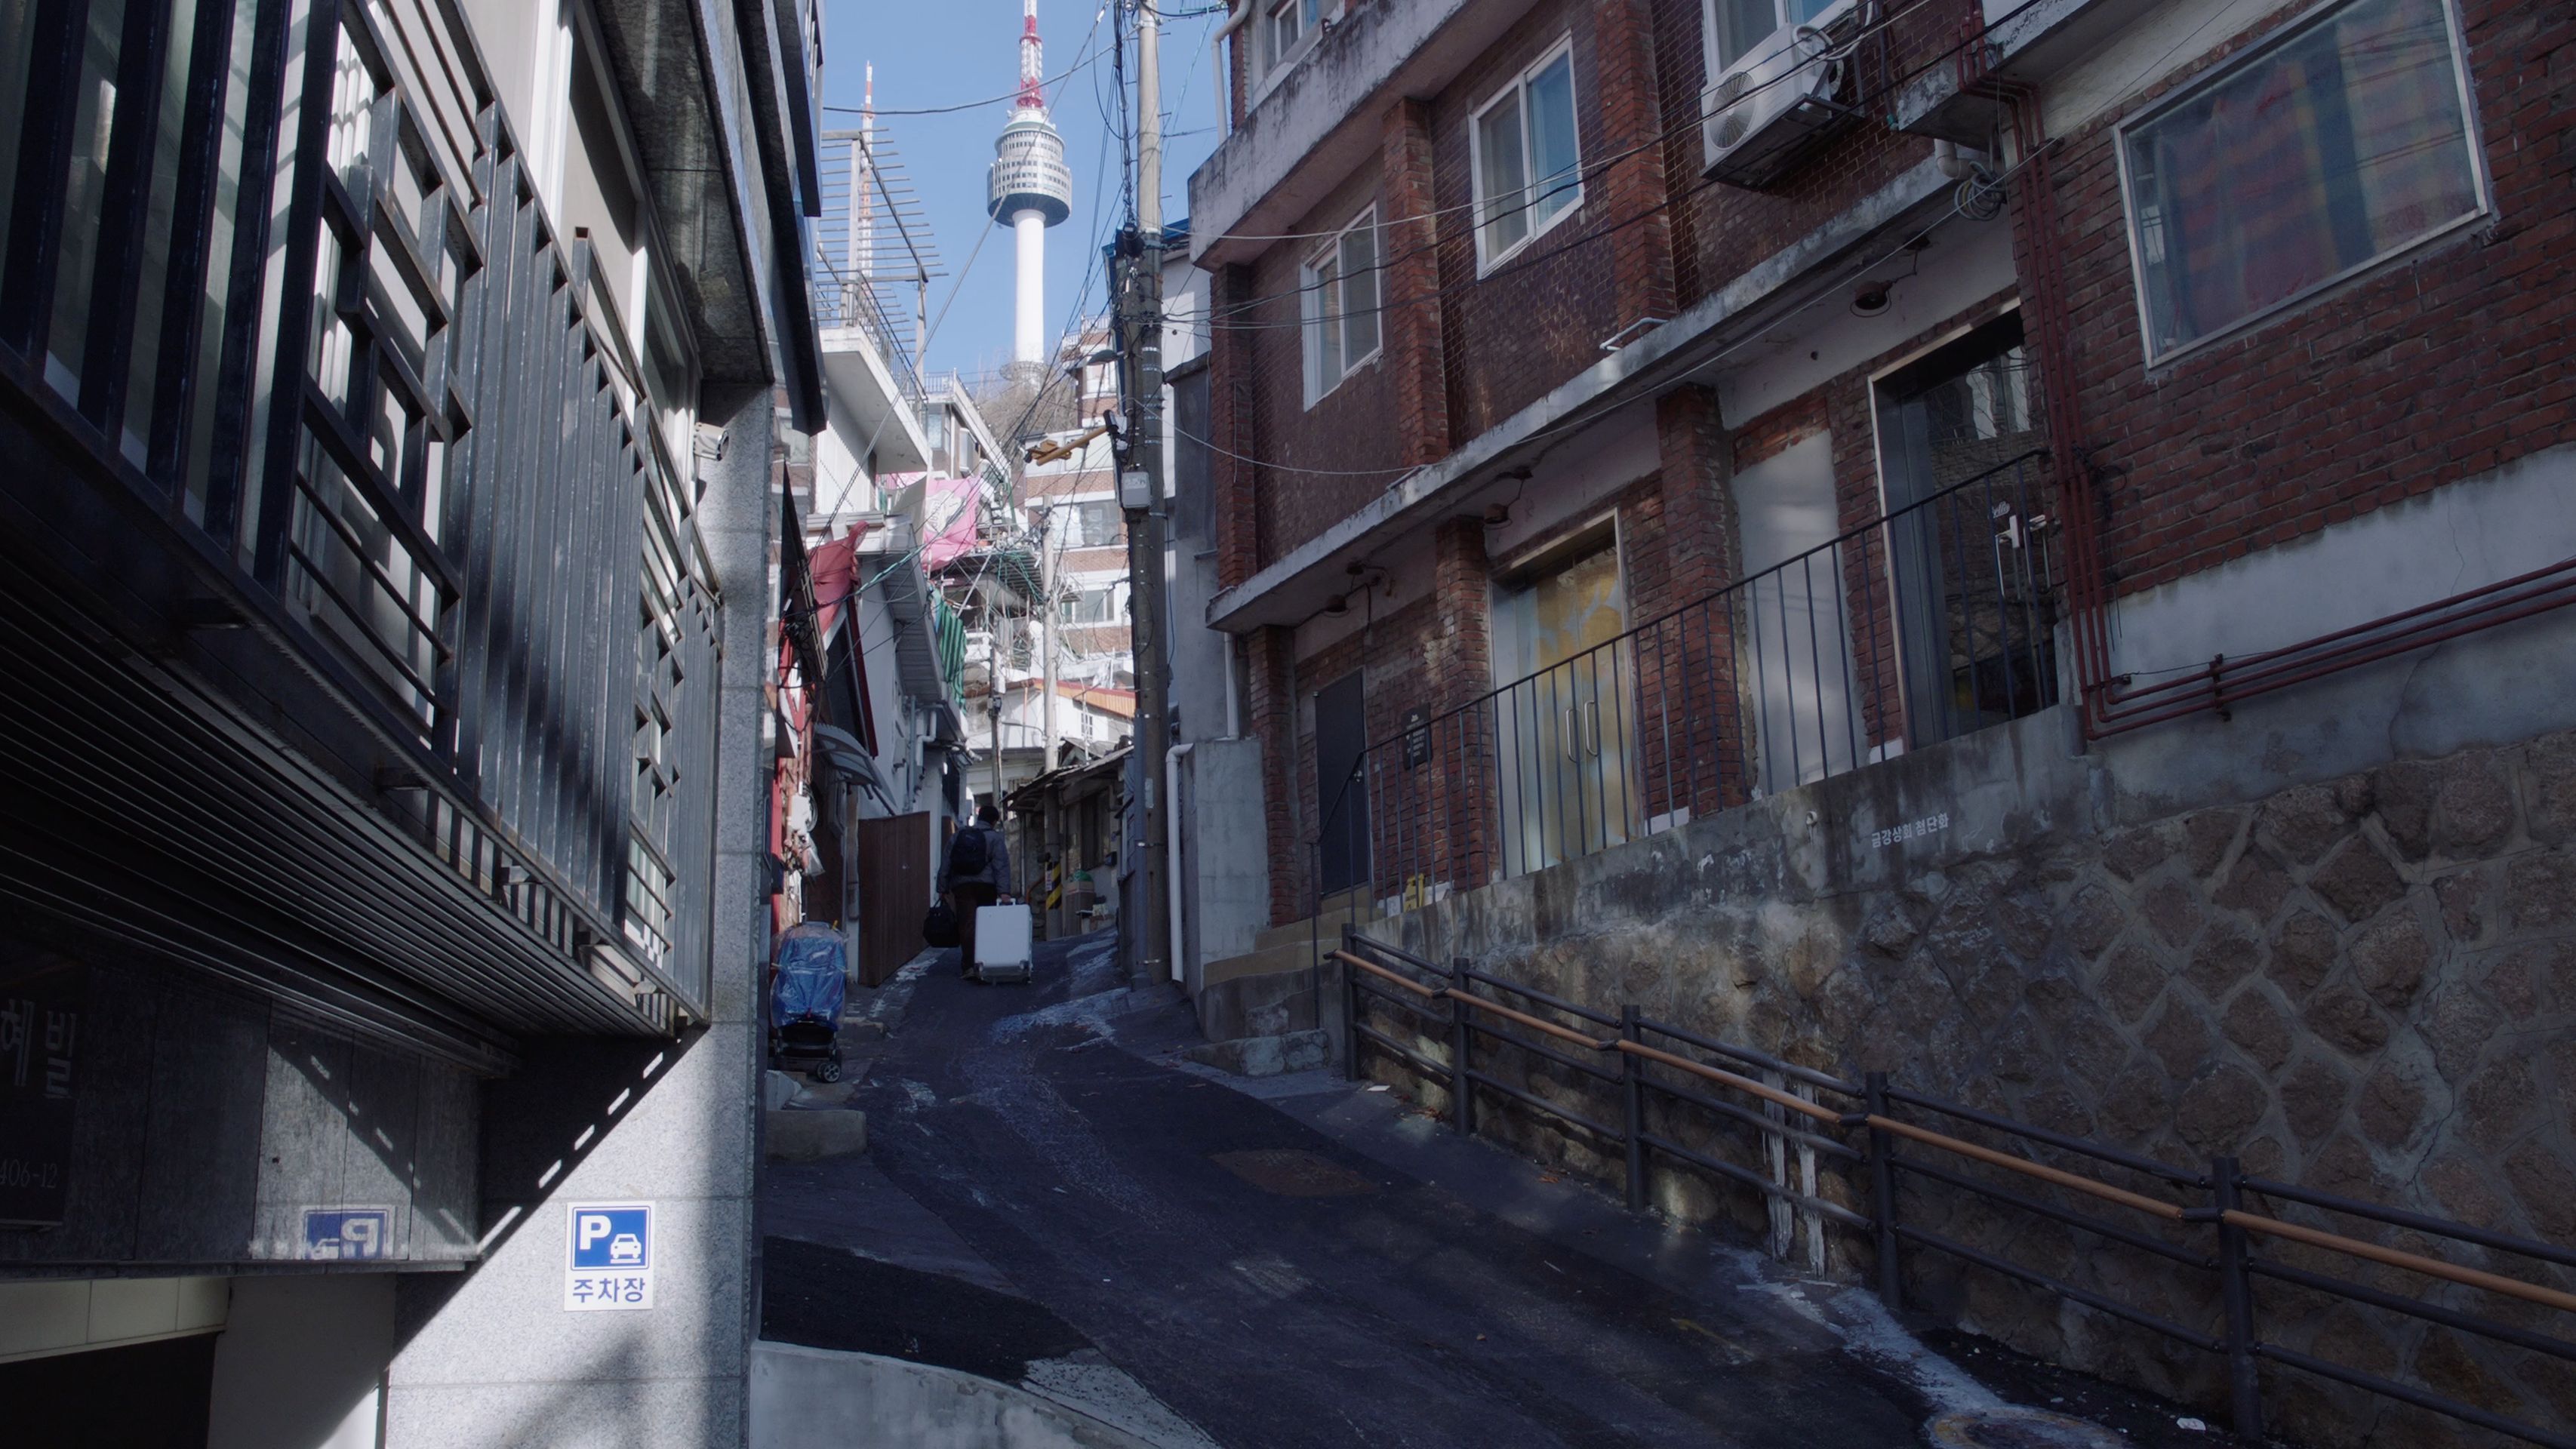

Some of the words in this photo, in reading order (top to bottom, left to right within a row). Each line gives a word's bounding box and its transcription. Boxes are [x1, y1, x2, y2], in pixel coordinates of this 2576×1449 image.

[1872, 823, 1912, 848] 금강상회
[580, 1215, 612, 1251] P
[573, 1278, 645, 1303] 주차장
